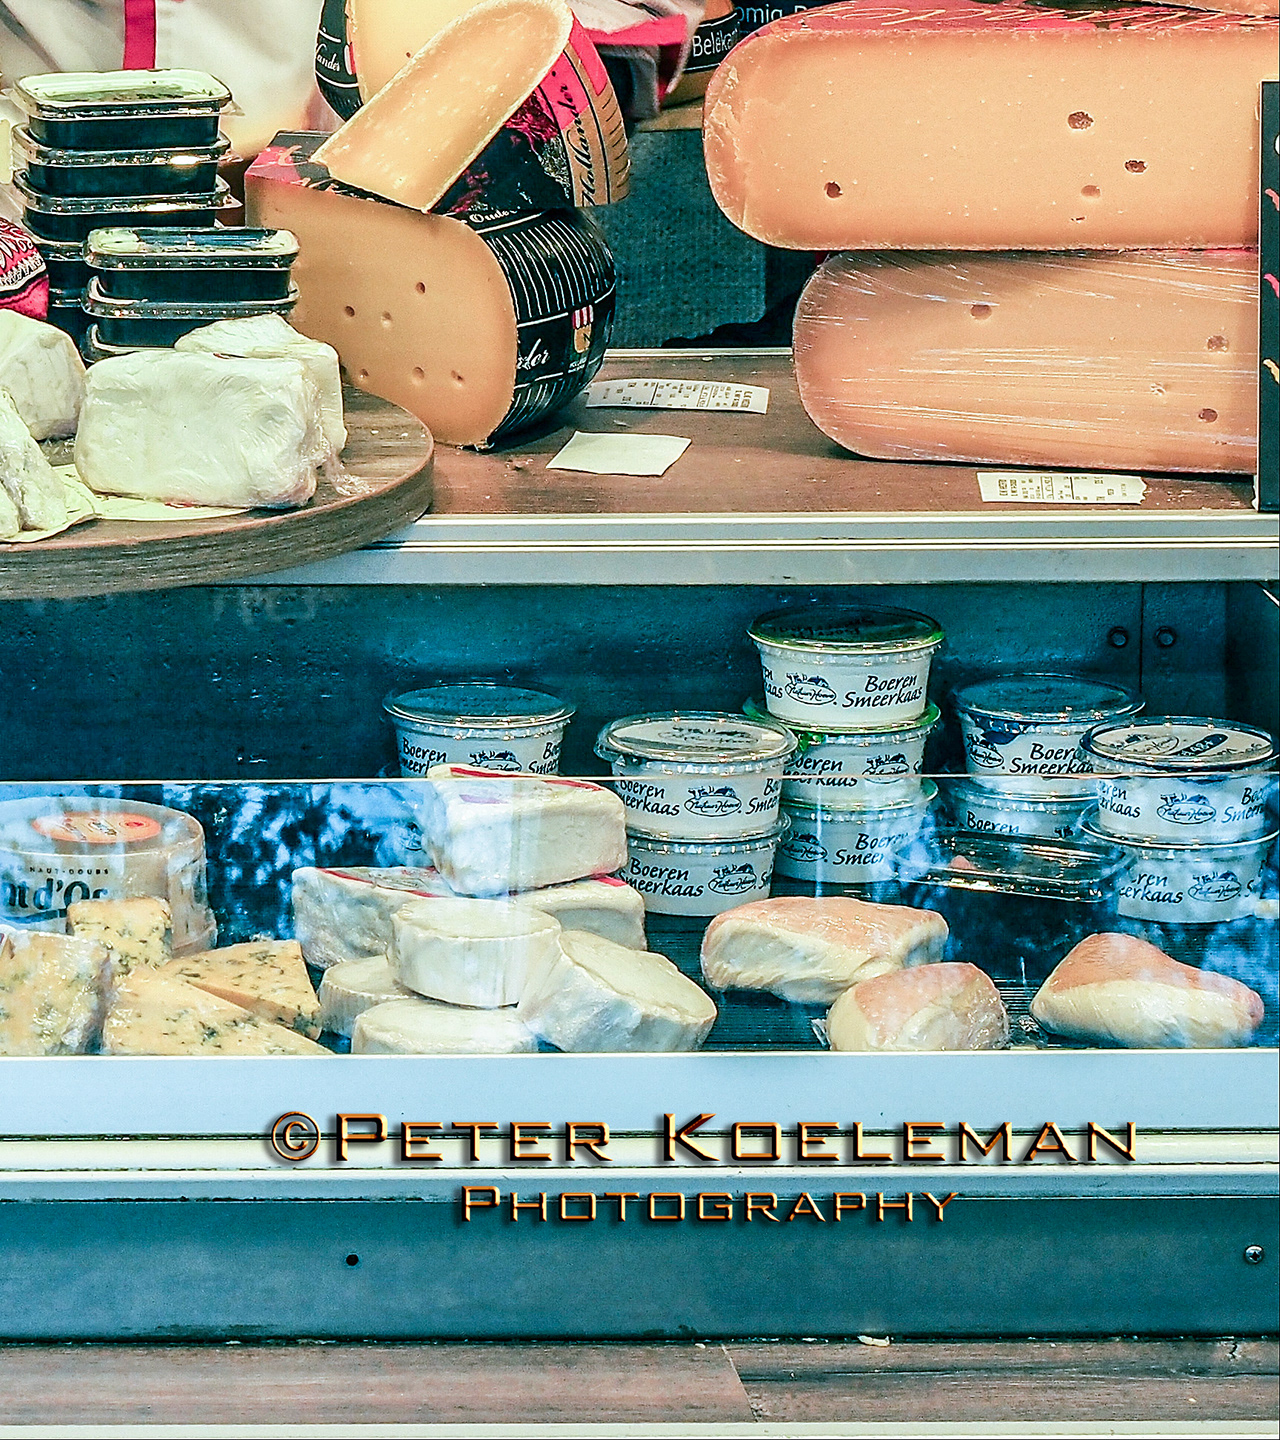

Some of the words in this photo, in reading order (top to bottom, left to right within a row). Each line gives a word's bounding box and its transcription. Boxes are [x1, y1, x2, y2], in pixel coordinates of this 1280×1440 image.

[865, 673, 918, 692] Boeren
[842, 686, 923, 708] Smeerkaas
[402, 738, 447, 763] Boeren
[630, 858, 689, 881] Boeren
[619, 870, 704, 897] Smeerkaas
